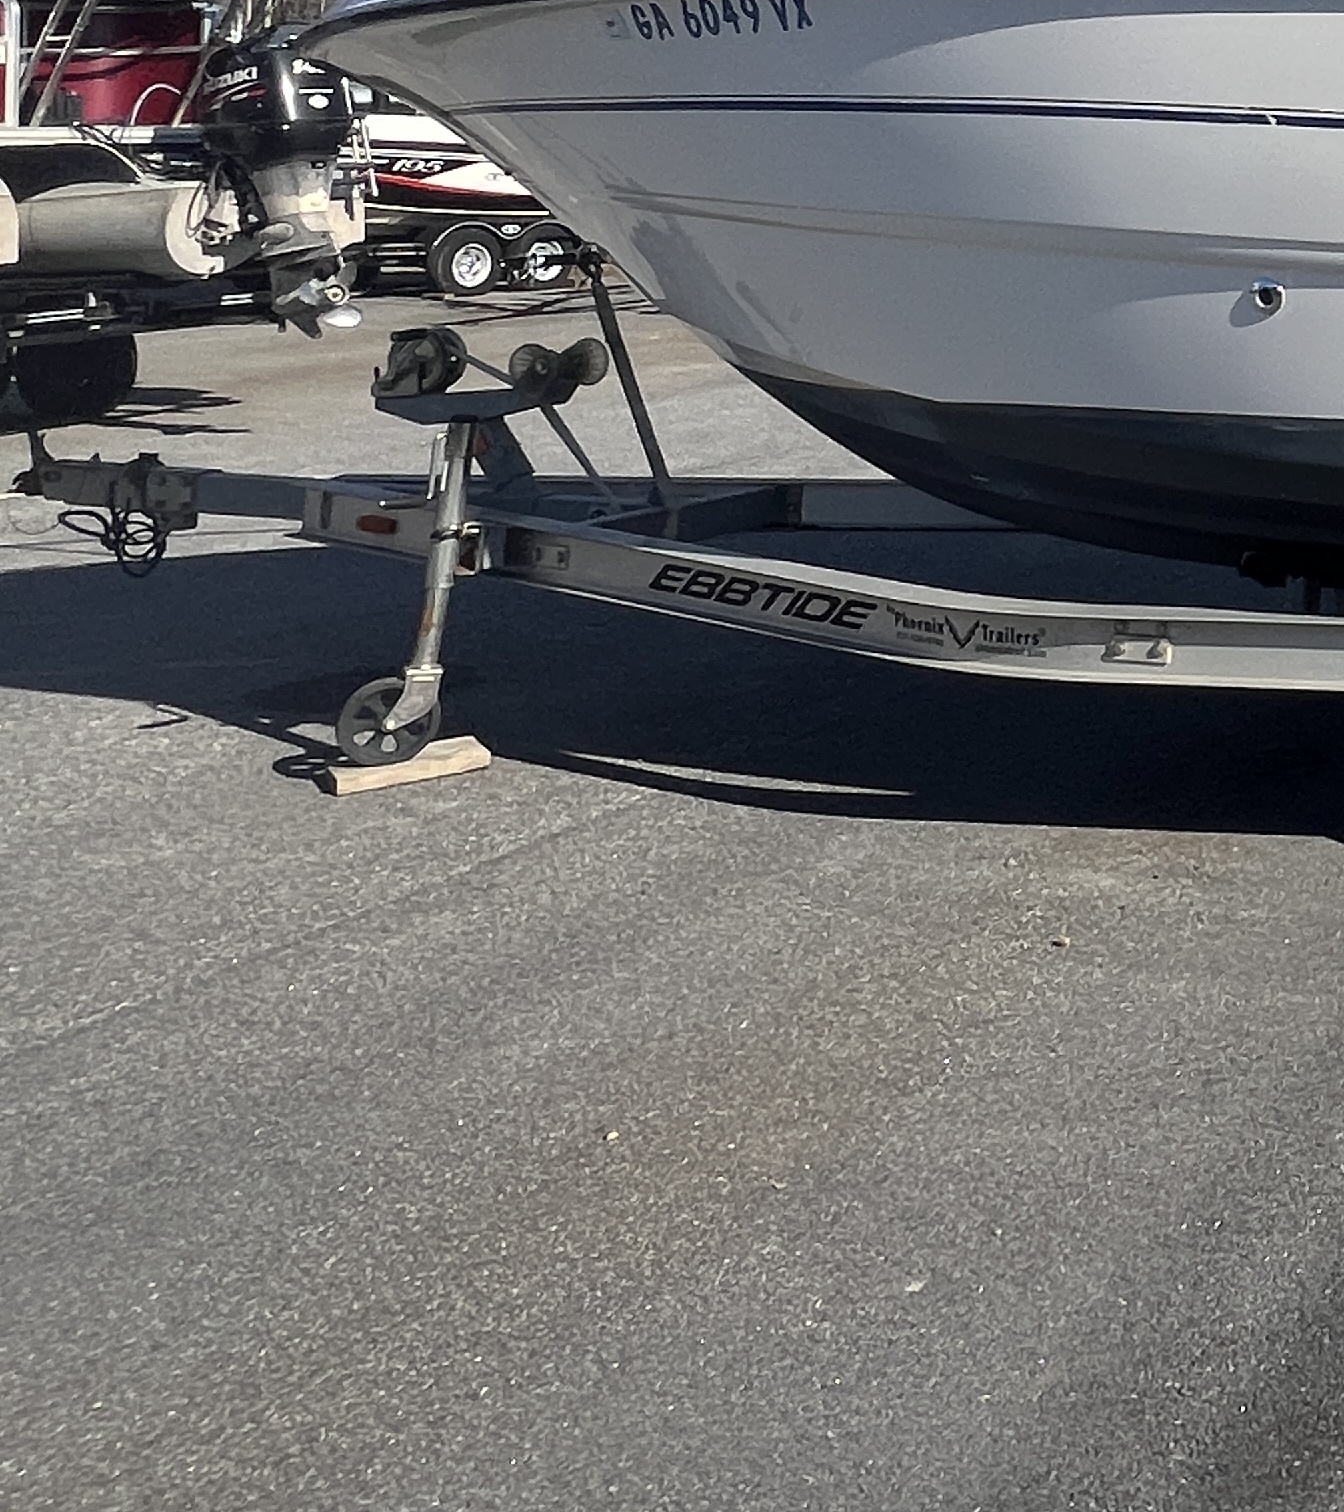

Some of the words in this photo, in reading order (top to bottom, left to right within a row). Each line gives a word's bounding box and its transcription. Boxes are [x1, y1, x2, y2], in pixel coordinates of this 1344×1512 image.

[630, 2, 675, 41] GA
[391, 158, 445, 173] 195
[648, 563, 878, 630] EBBTIDE
[981, 622, 1041, 646] Trailers
